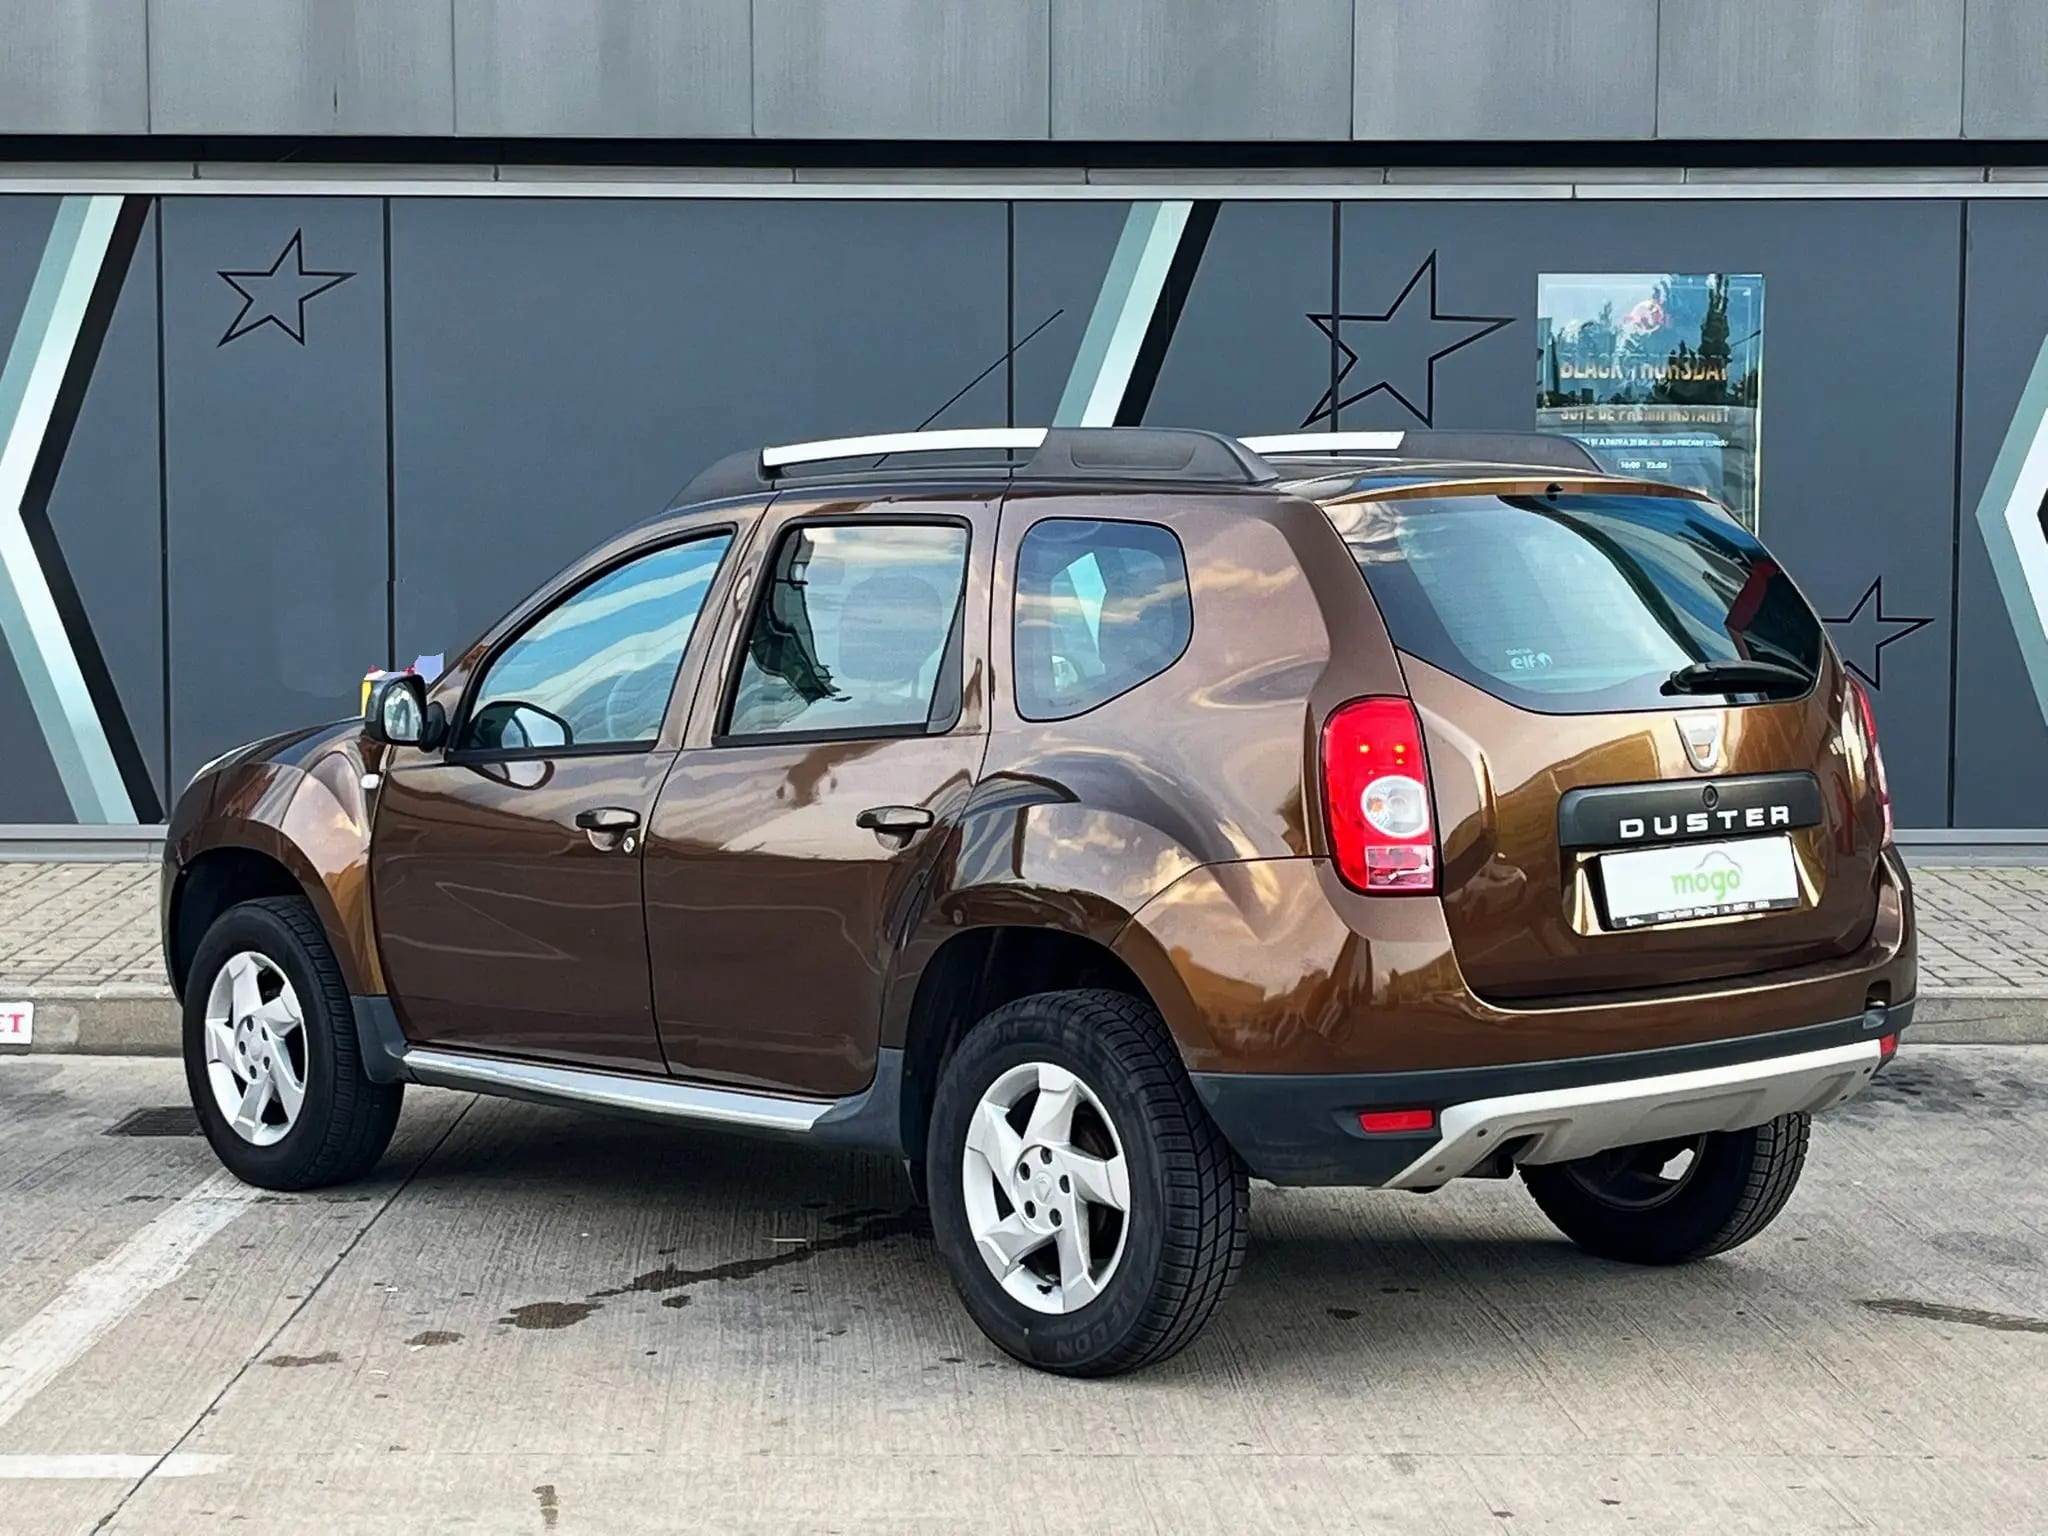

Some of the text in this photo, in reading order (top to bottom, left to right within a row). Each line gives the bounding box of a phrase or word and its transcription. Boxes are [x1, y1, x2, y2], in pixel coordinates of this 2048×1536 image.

[1510, 654, 1537, 669] elf
[1619, 805, 1791, 838] DUSTER
[1671, 868, 1741, 901] mogo
